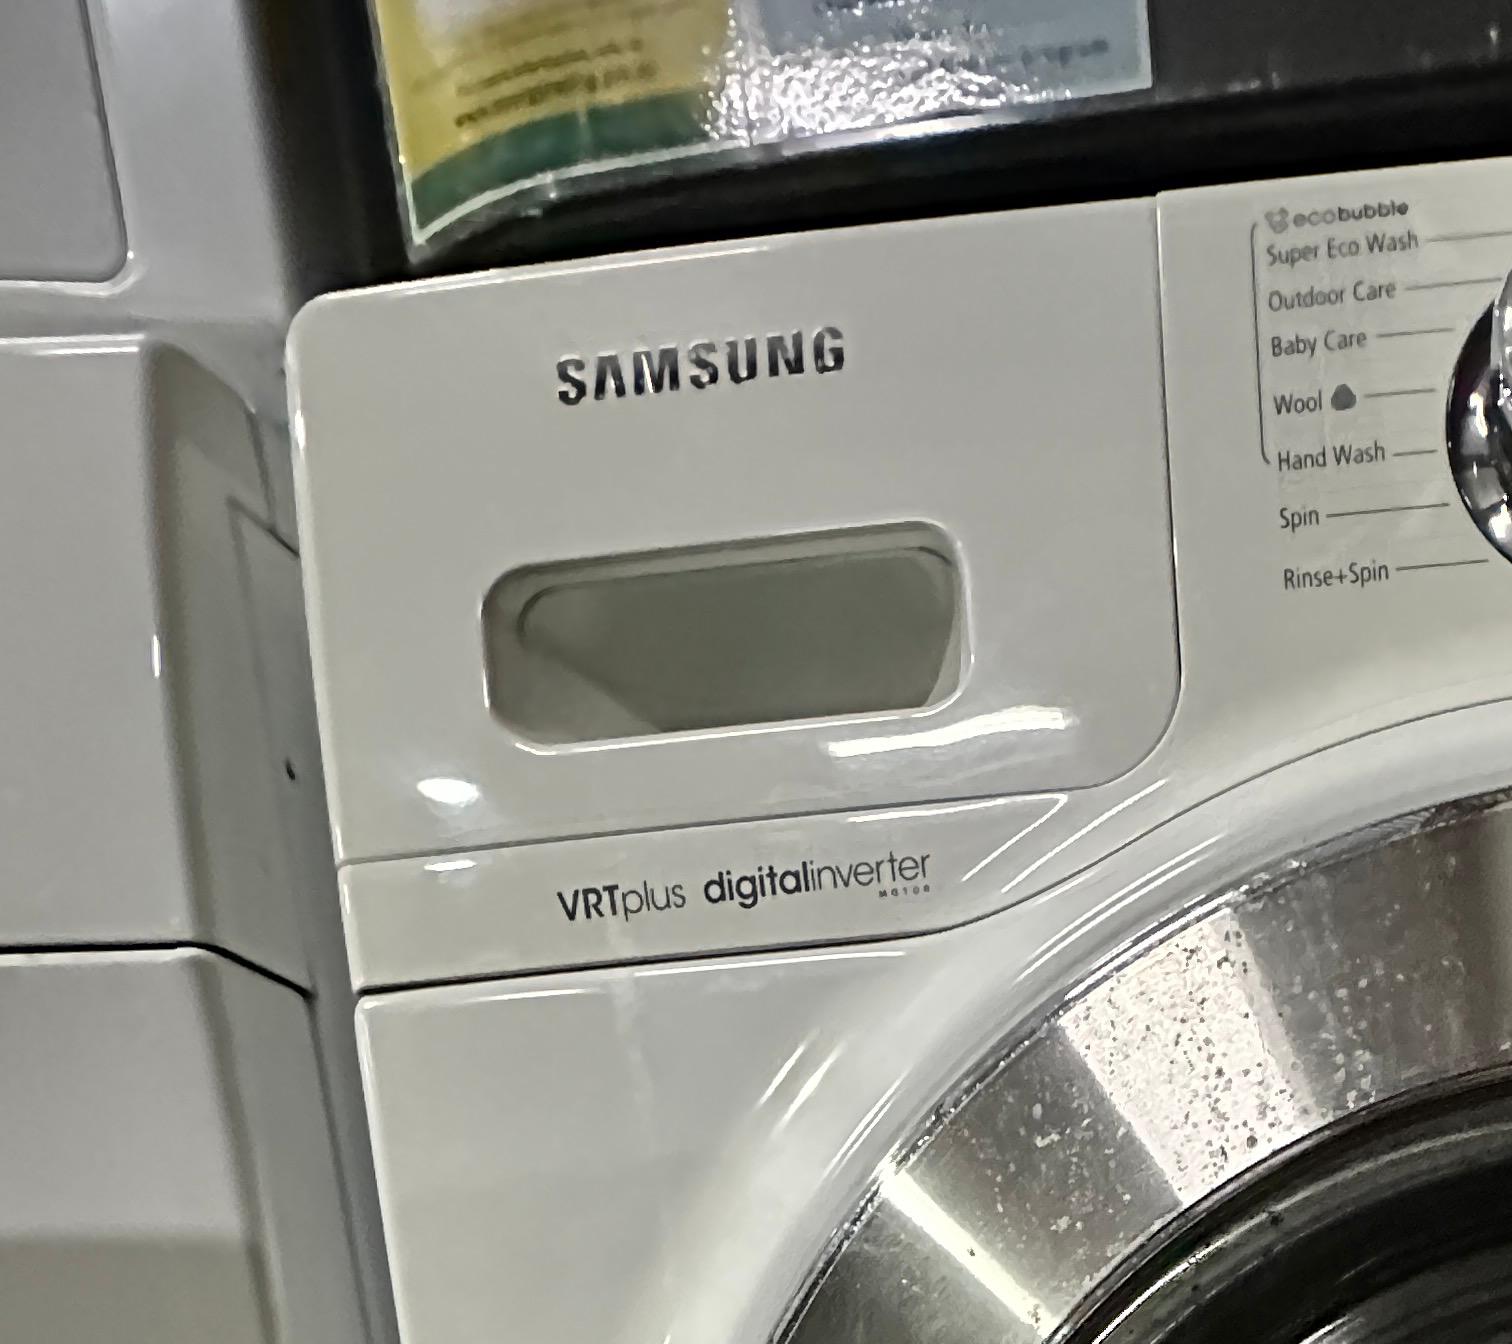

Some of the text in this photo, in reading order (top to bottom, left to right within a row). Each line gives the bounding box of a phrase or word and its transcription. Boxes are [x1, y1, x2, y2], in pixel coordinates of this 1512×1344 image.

[1292, 200, 1409, 228] ecobubble
[1266, 230, 1420, 269] Super Eco Wash
[1268, 280, 1397, 313] Outdoor Care
[1271, 329, 1368, 359] Baby Care
[556, 326, 846, 406] SAMSUNG
[1273, 390, 1323, 417] Wool
[1277, 440, 1386, 473] Hand Wash
[1279, 505, 1320, 533] Spin
[1283, 559, 1390, 591] Rinse+Spin
[556, 850, 931, 923] VRTplus digitalinverter
